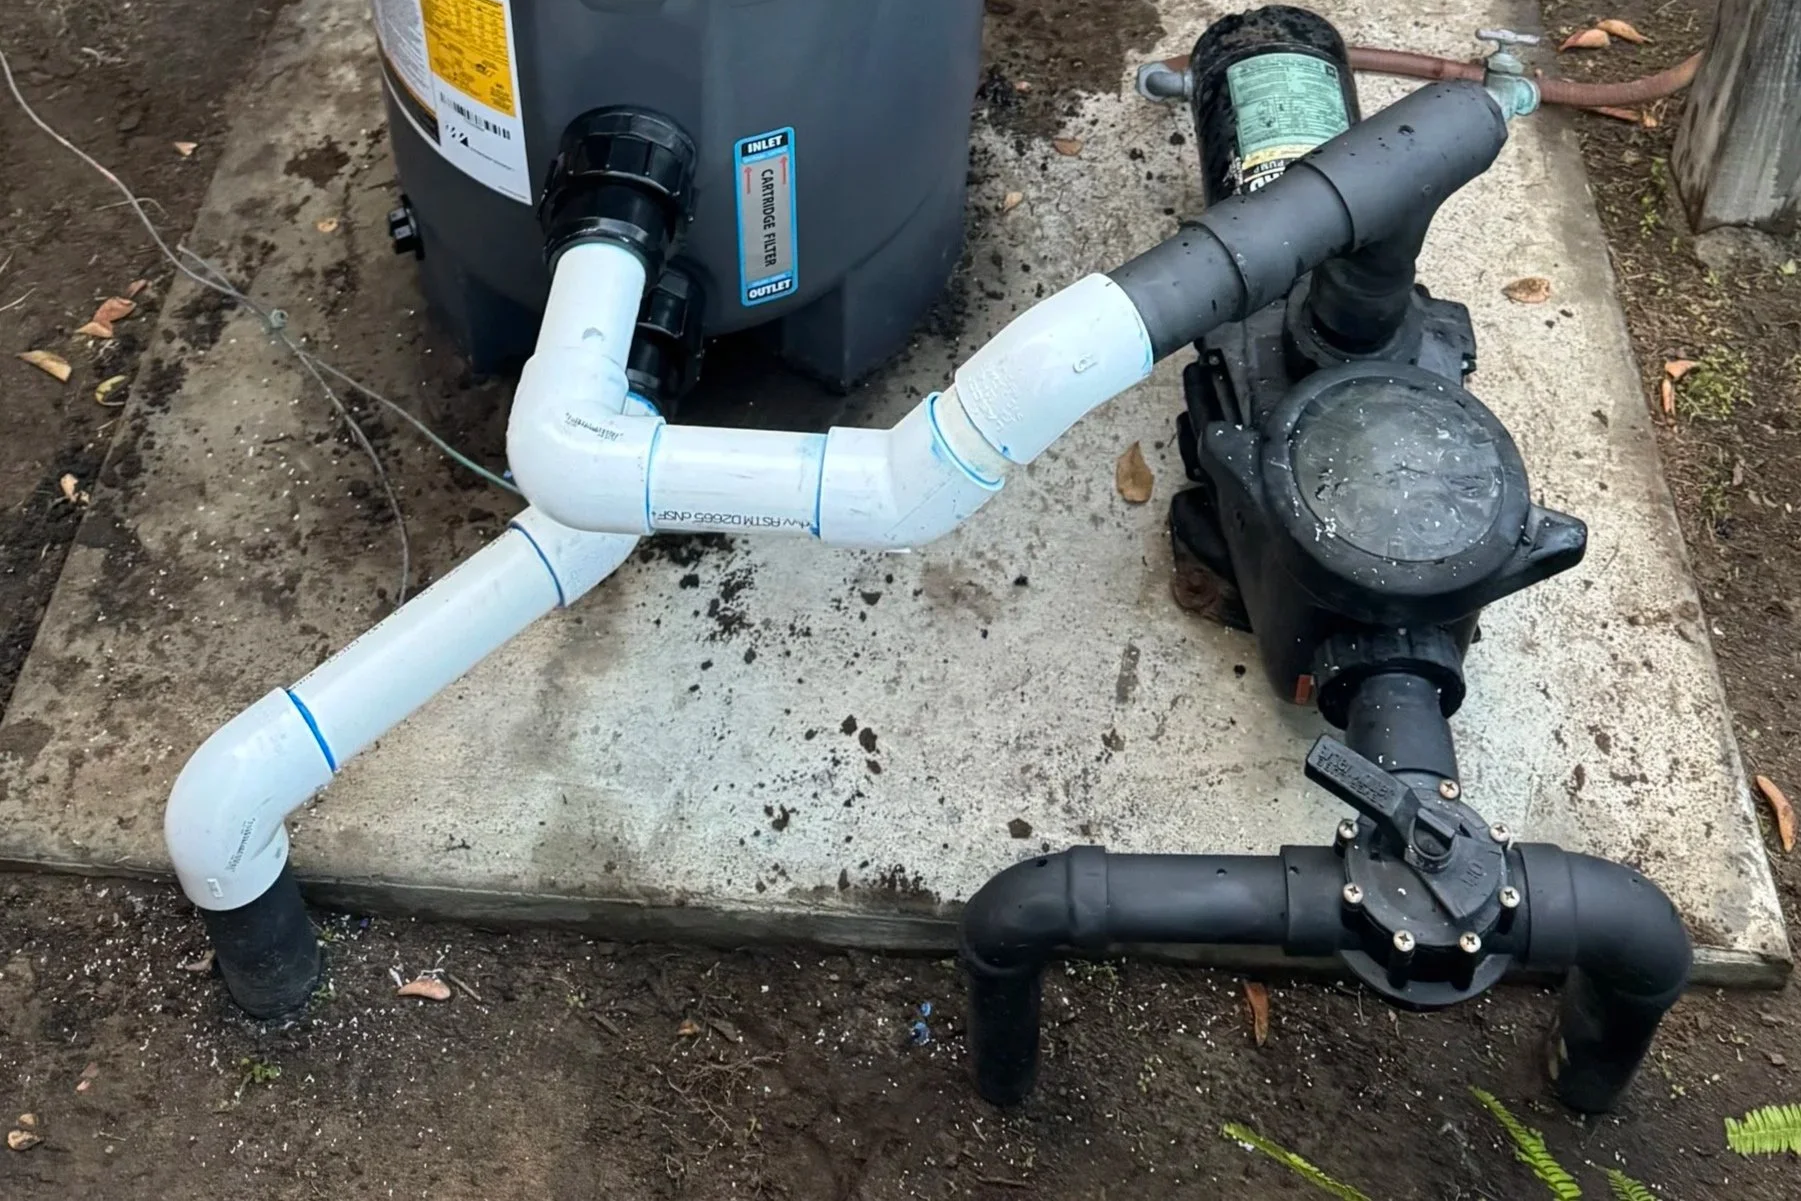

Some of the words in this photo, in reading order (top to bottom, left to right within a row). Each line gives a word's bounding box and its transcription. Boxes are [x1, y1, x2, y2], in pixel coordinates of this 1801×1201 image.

[747, 135, 783, 153] INLET
[761, 168, 776, 230] CARTRIDGE
[763, 232, 777, 268] FILTER
[748, 279, 792, 299] OUTLET
[694, 513, 742, 524] D2665
[743, 516, 781, 527] ASTM
